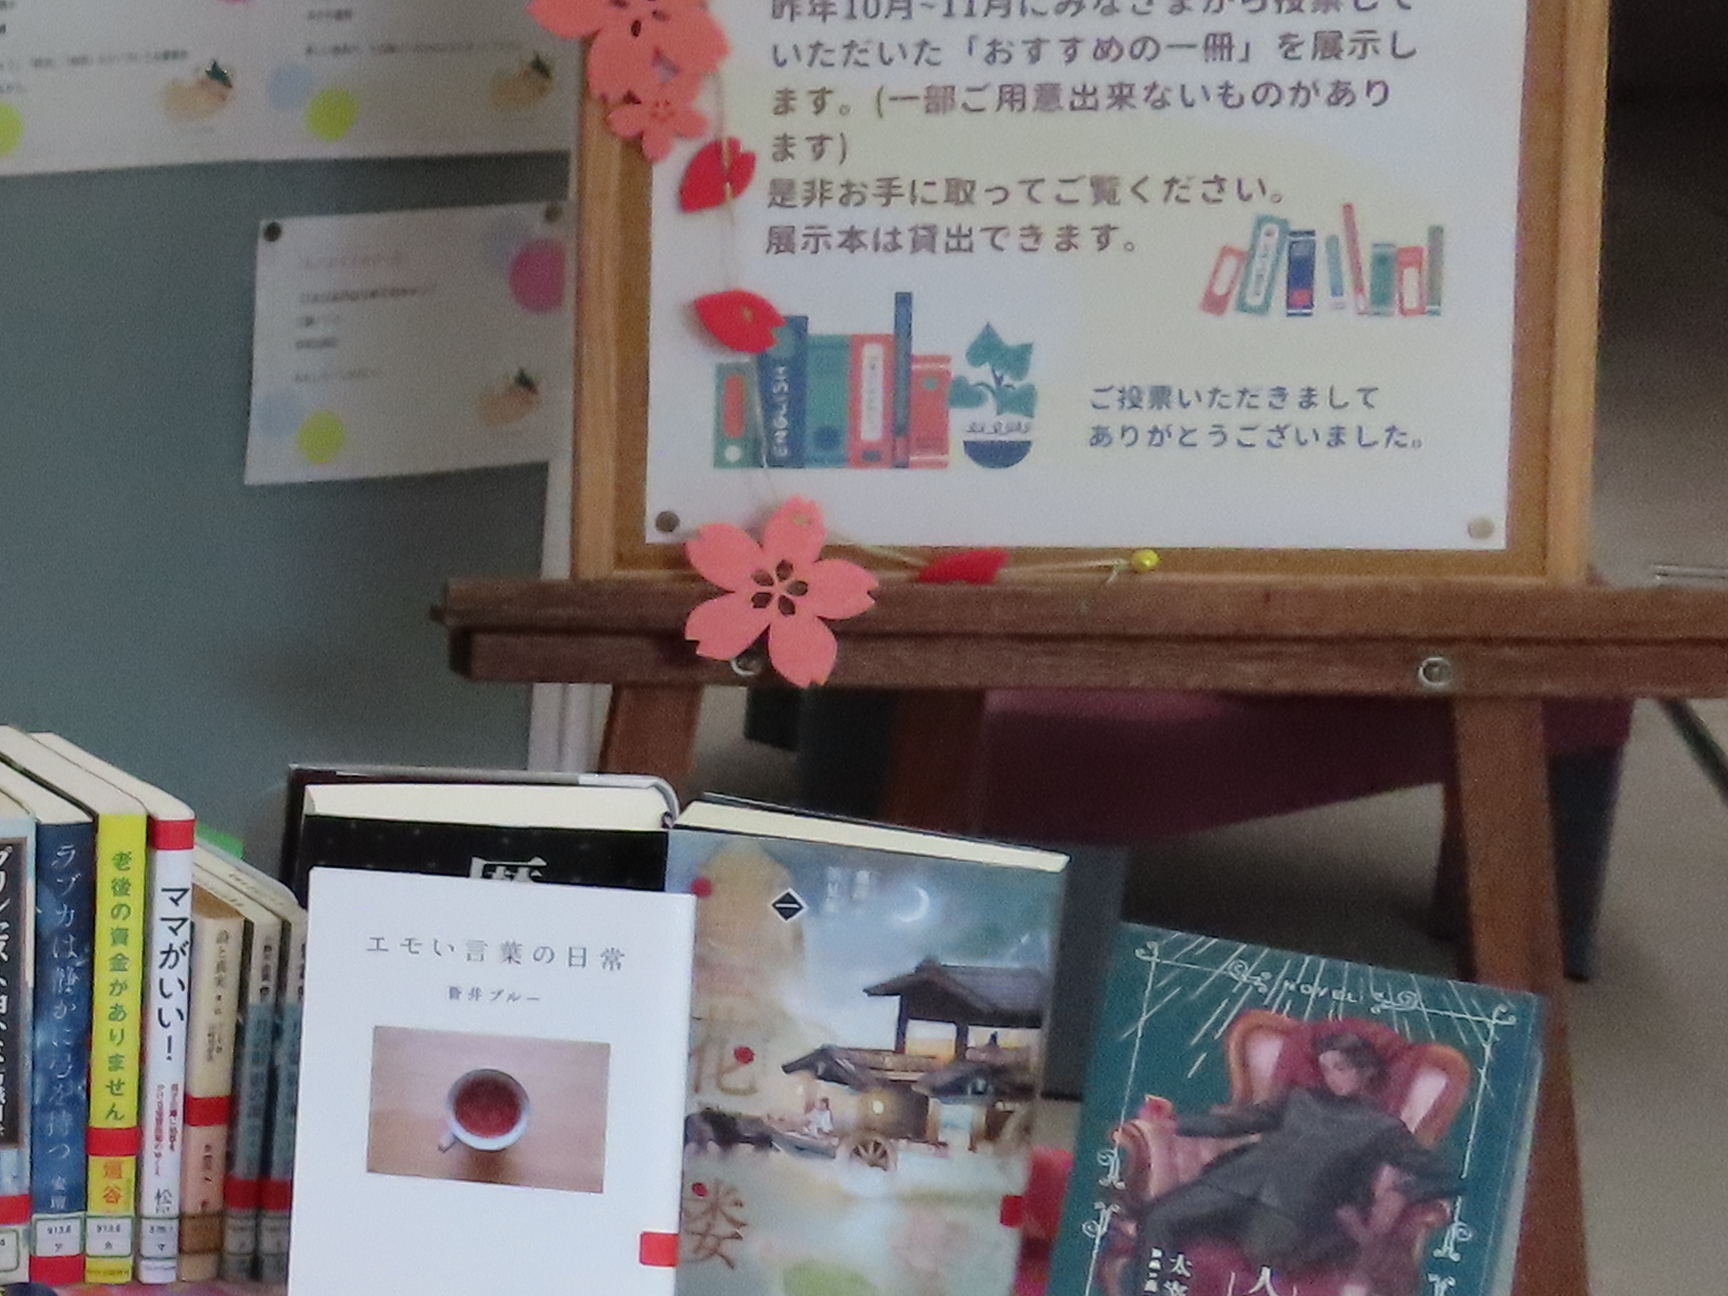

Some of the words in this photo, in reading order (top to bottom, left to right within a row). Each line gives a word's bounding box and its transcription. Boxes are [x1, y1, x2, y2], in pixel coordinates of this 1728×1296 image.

[770, 26, 1417, 70] いただいた「おすすめの一冊」を展示し
[766, 172, 1284, 212] 是非お手に取ってご覧ください。
[766, 218, 1140, 258] 展示本は貸出できます。
[1087, 382, 1379, 413] ご投票いただきまして
[1087, 420, 1423, 452] ありがとうございました。
[365, 935, 627, 973] エモい言葉の日常
[106, 850, 134, 1122] 老後の資金がありません
